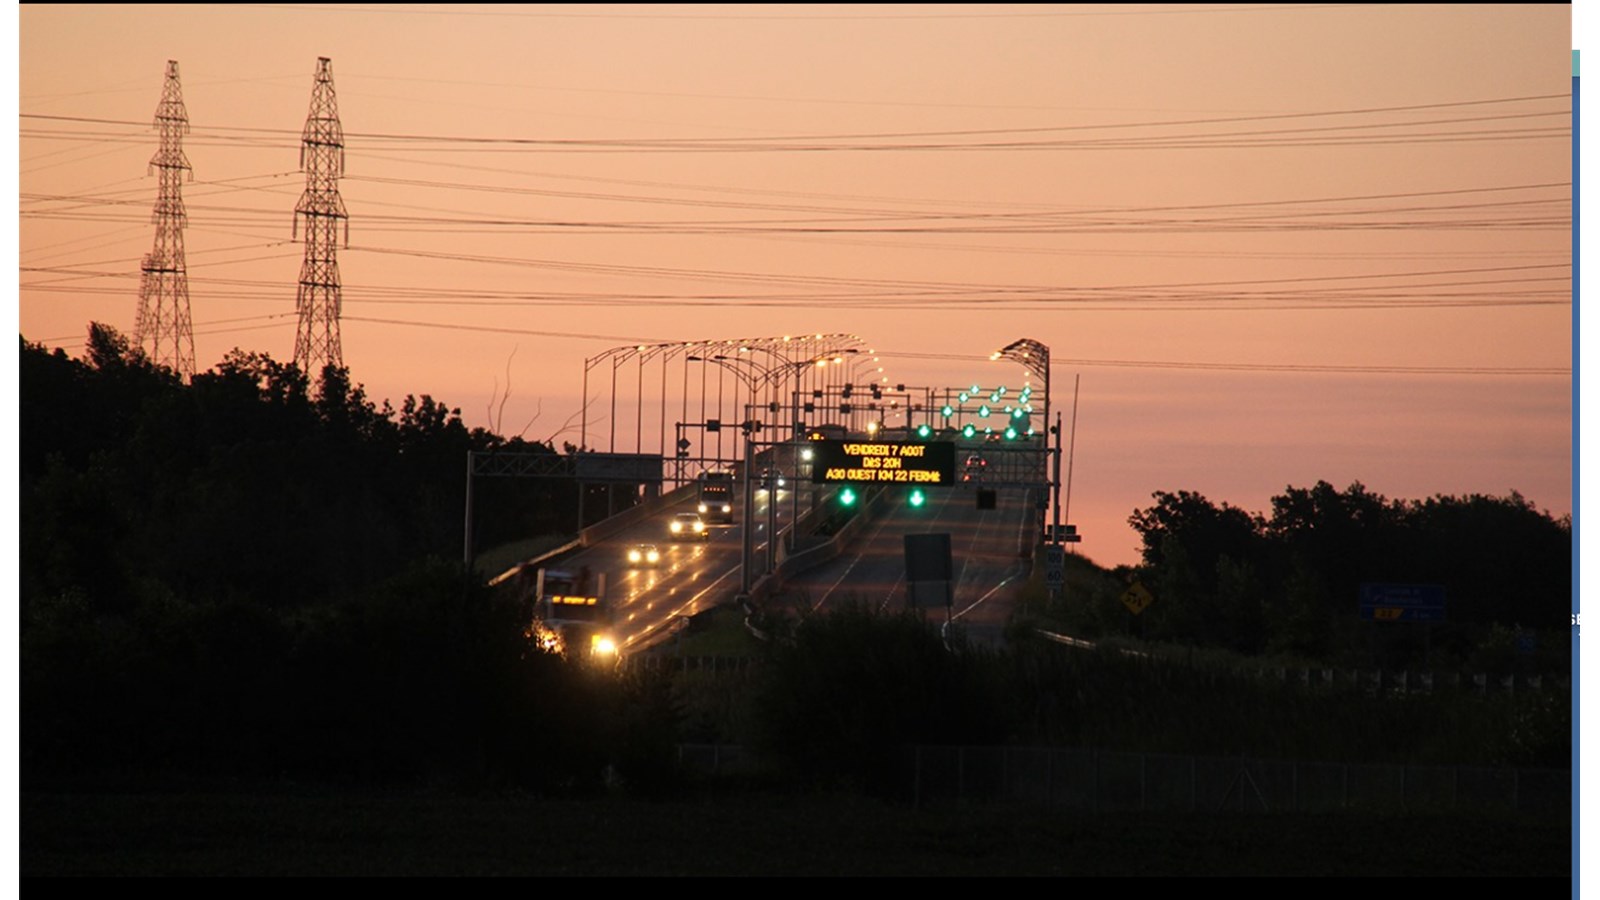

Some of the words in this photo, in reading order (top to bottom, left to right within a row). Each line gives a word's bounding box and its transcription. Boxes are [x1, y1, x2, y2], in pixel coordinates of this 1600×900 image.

[843, 444, 889, 456] VENDREDI
[891, 445, 898, 456] 7
[883, 457, 901, 469] 20H
[826, 468, 845, 480] A30
[847, 469, 876, 481] OUEST
[878, 470, 893, 481] KM
[895, 470, 907, 481] 22
